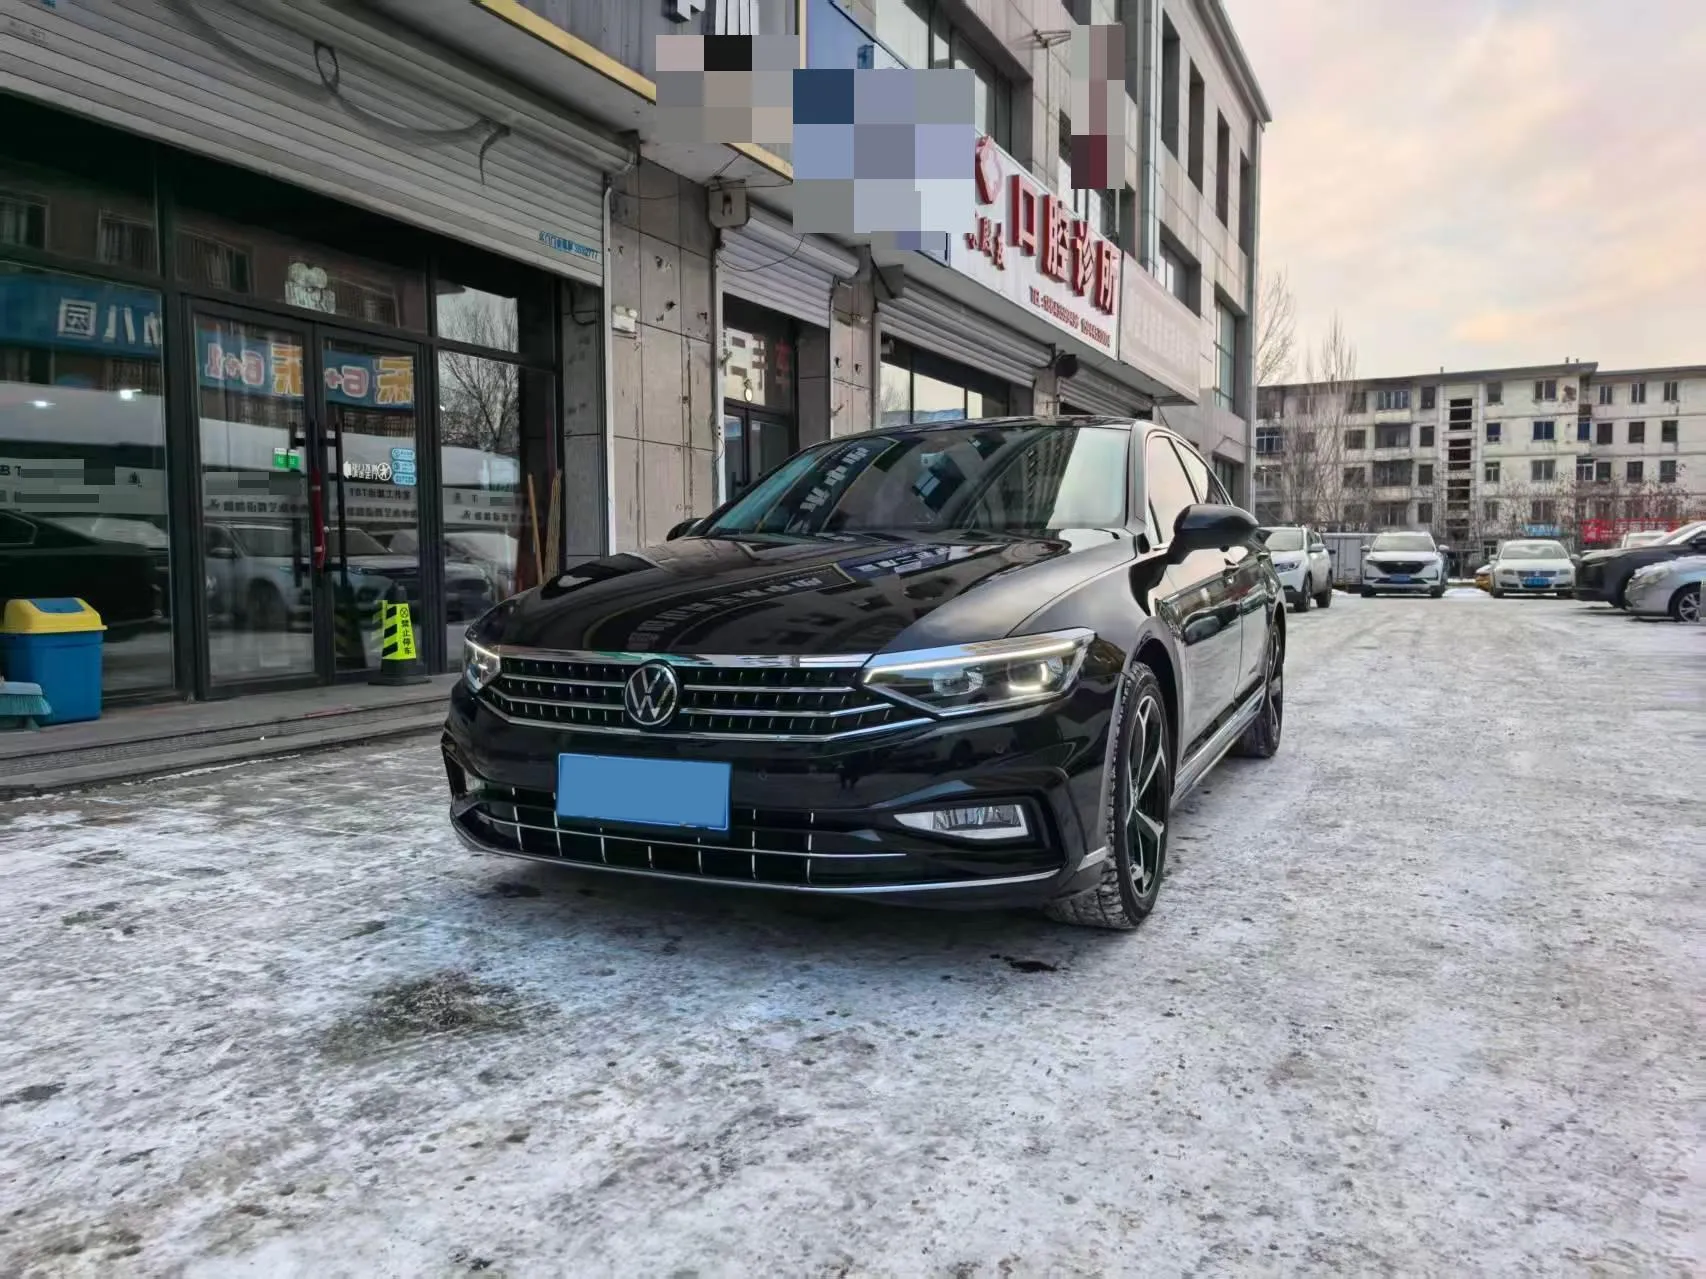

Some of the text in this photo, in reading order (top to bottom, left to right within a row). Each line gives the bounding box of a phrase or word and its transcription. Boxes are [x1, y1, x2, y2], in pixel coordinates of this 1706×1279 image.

[1011, 174, 1120, 315] 口腔诊所
[401, 619, 412, 655] 禁止停车
